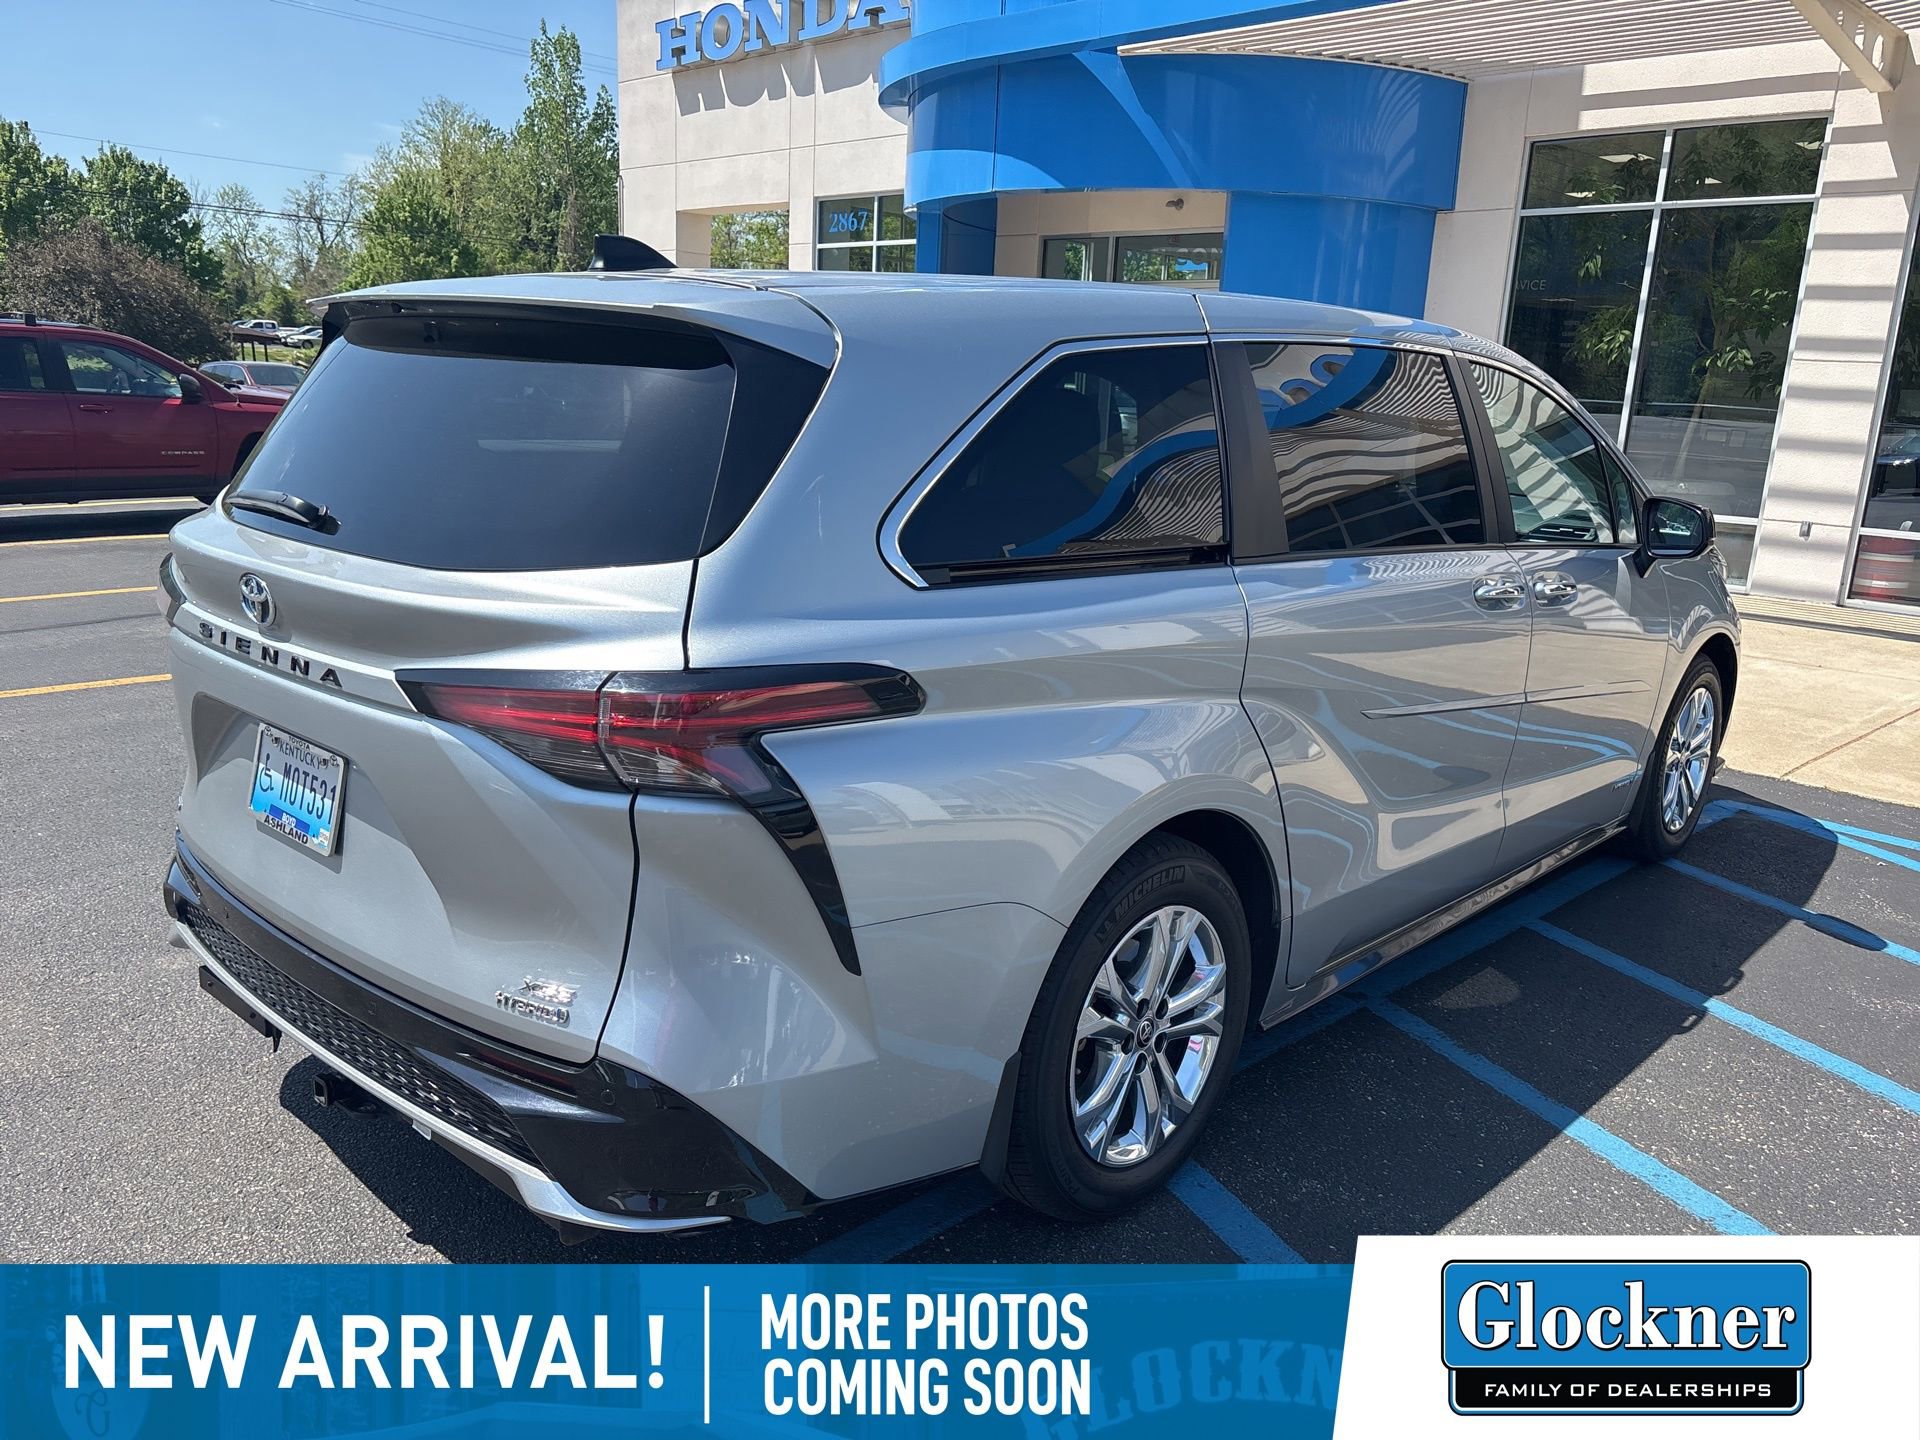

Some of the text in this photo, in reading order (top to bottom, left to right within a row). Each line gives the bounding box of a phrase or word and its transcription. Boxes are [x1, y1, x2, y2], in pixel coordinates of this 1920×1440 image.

[655, 0, 910, 71] HONDA
[829, 210, 868, 233] 2867
[1516, 279, 1547, 291] VICE
[198, 622, 343, 688] SIENNA
[279, 741, 322, 771] KENTUCKY
[288, 735, 310, 750] TOYOTA
[263, 814, 309, 845] ASHLAND
[1114, 864, 1185, 921] MICHELIN
